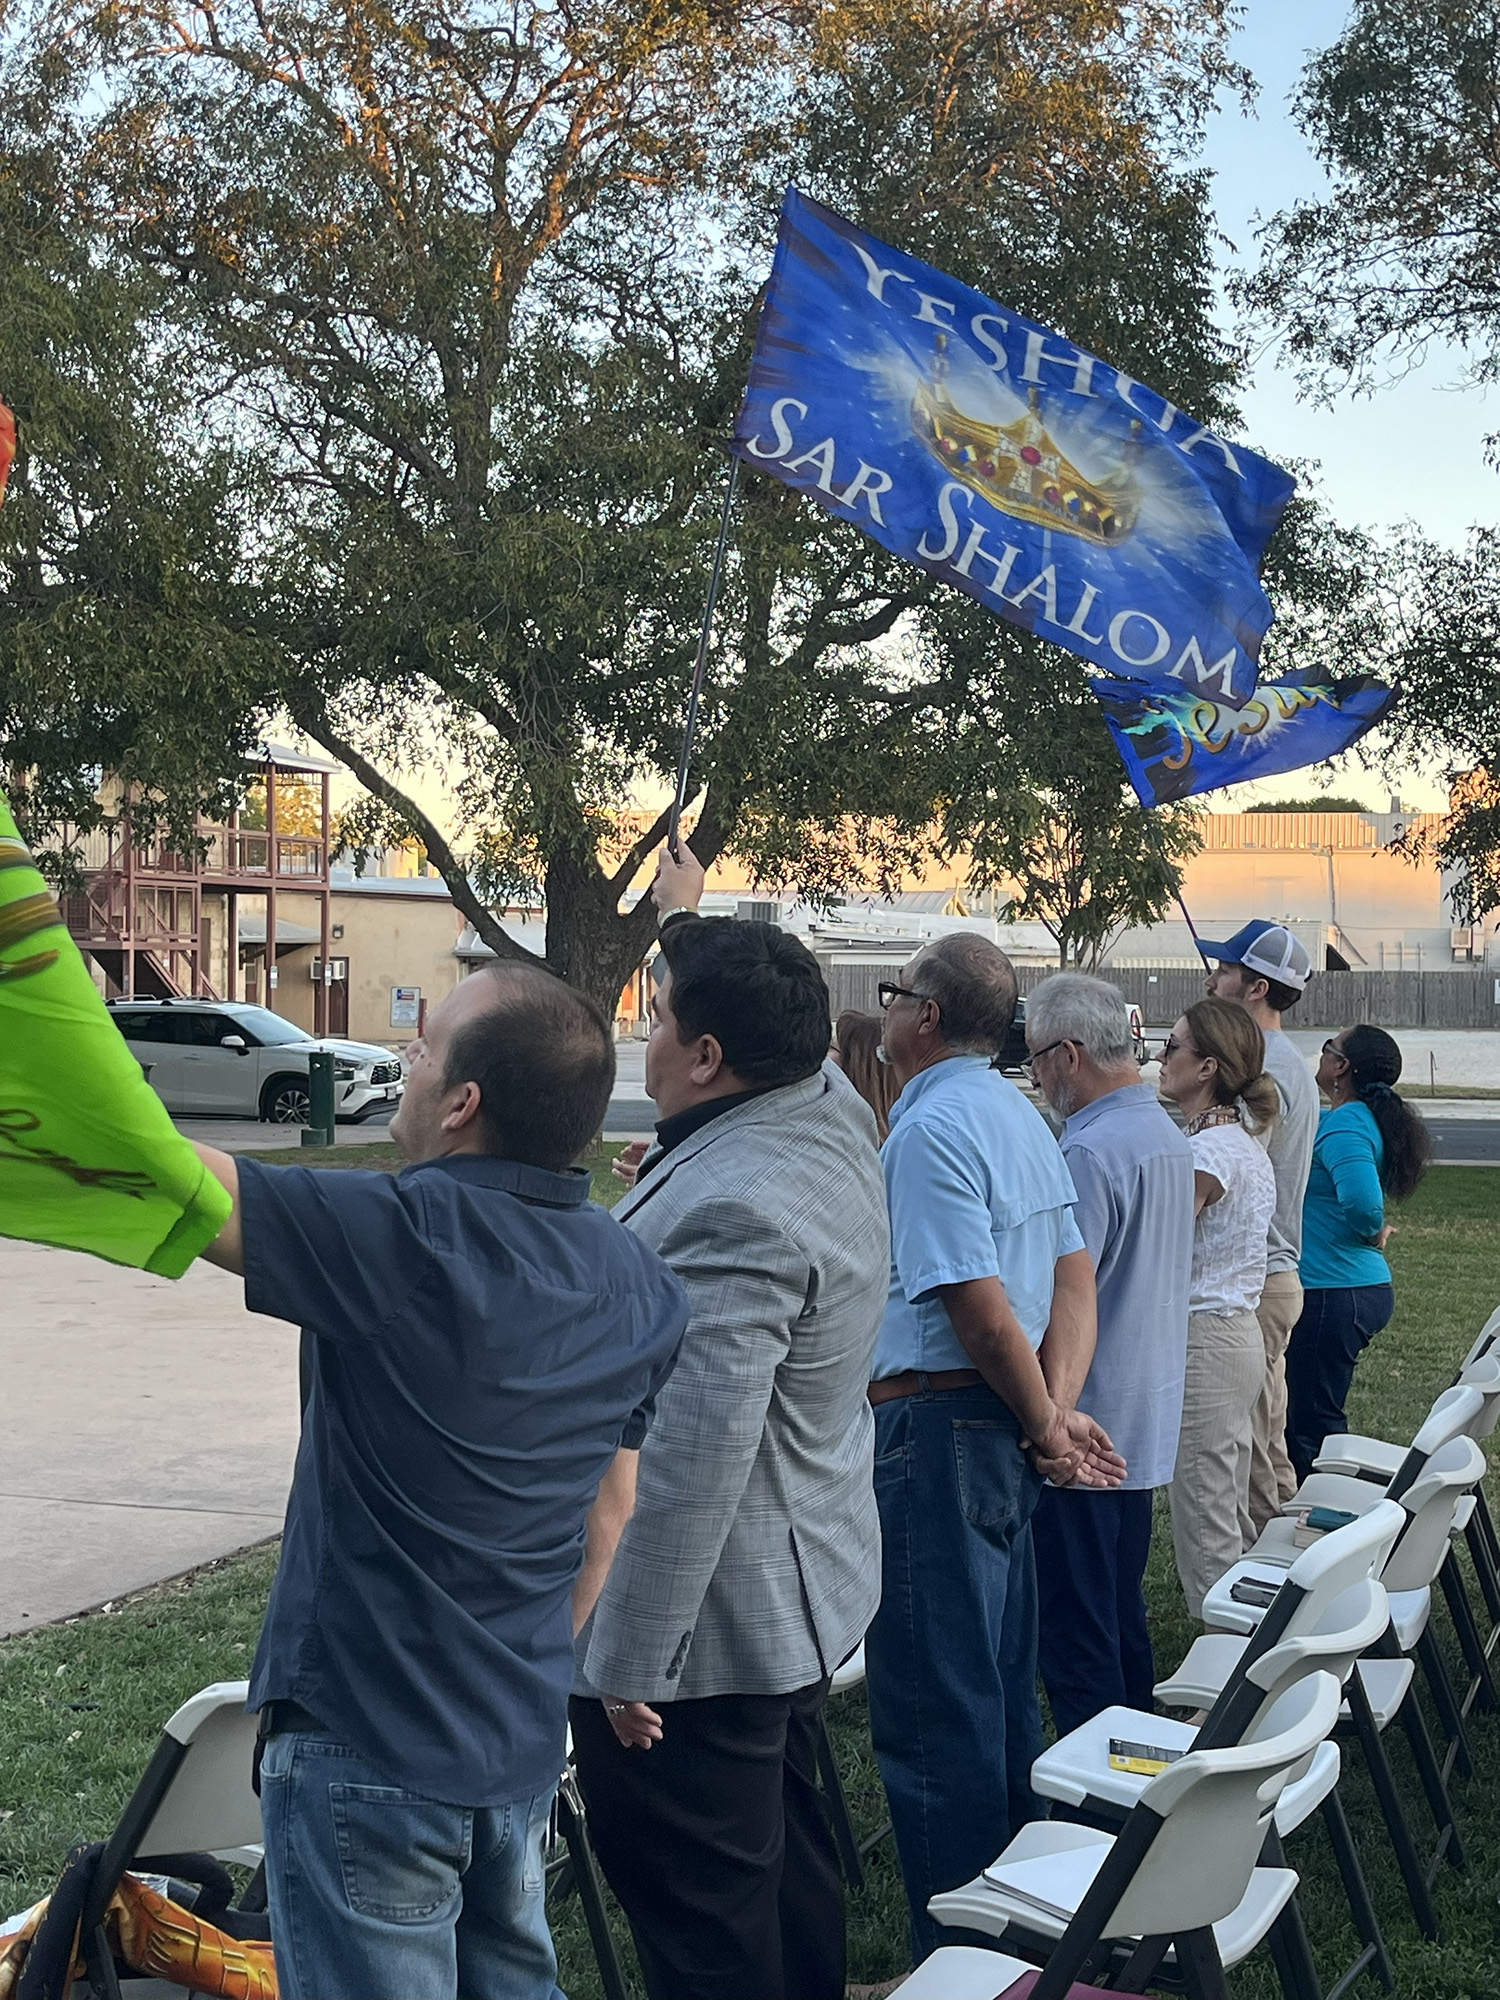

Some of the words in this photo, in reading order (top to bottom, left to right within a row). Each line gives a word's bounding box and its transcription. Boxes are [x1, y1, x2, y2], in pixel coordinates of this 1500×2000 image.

[842, 237, 1247, 481] YESHUA
[747, 396, 894, 529] SAR
[916, 481, 1238, 700] SHALOM
